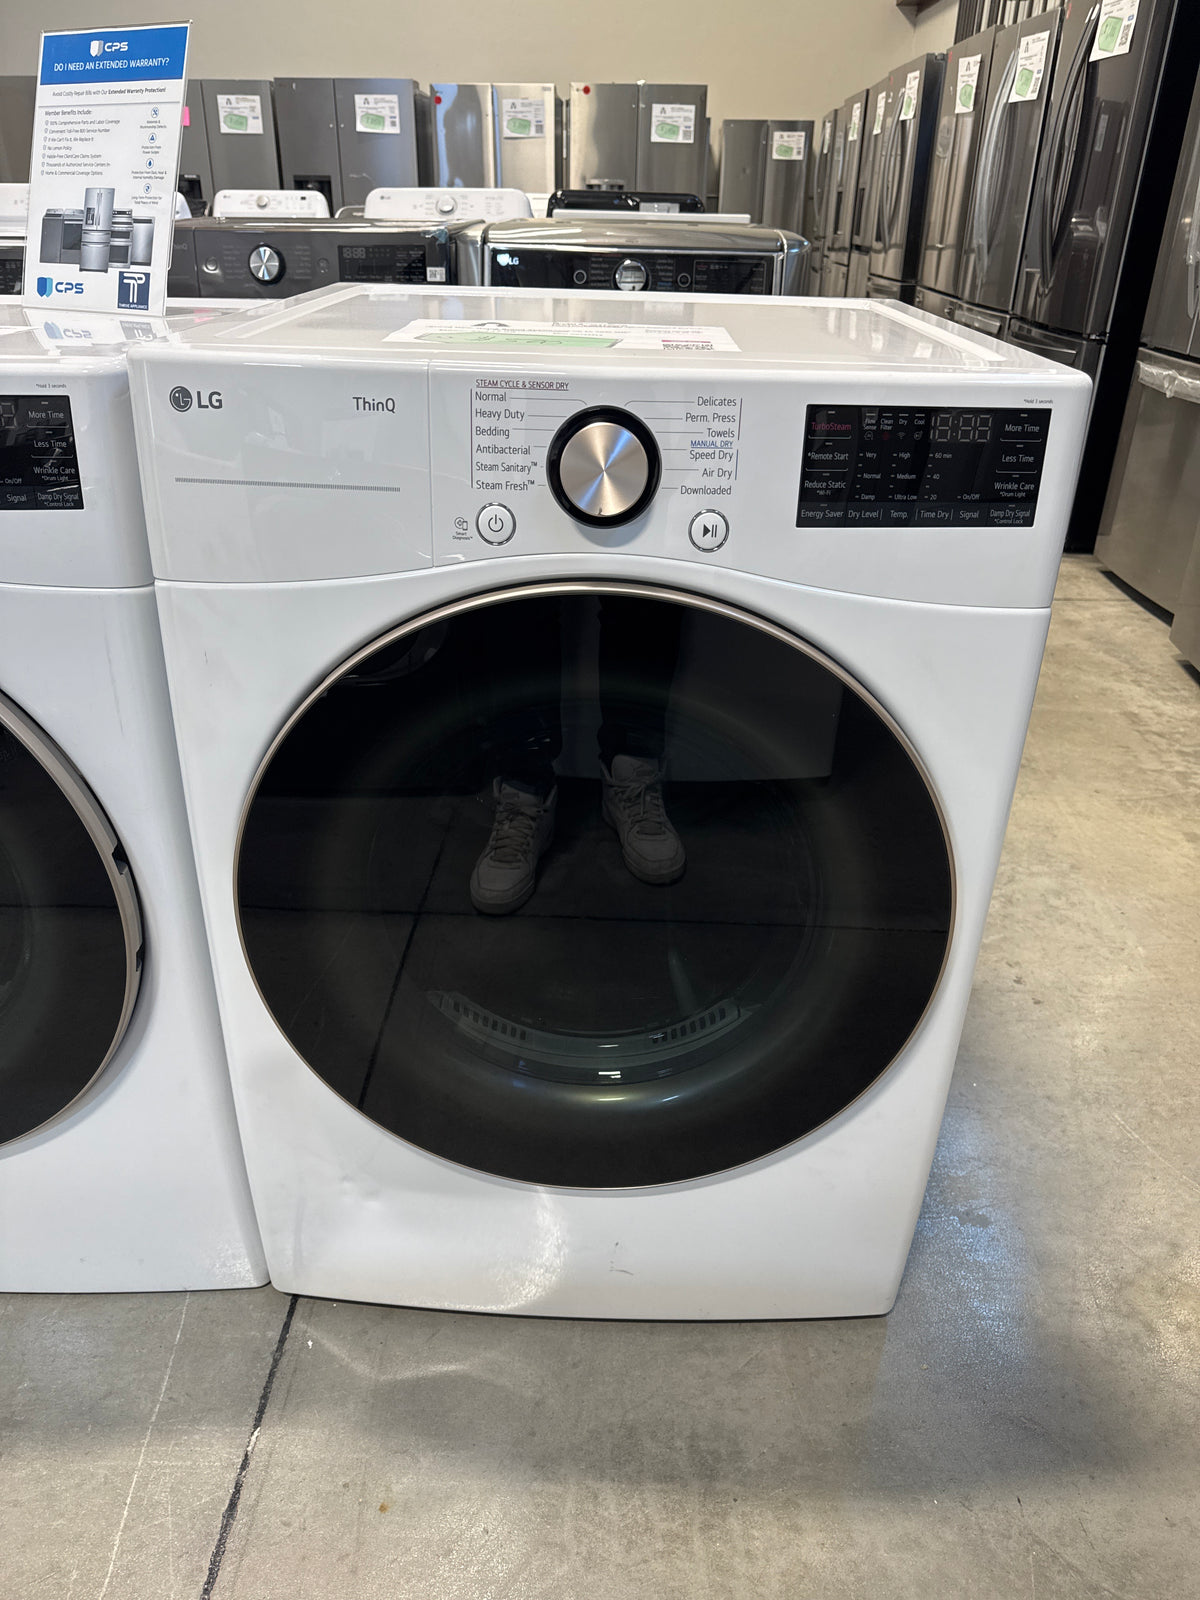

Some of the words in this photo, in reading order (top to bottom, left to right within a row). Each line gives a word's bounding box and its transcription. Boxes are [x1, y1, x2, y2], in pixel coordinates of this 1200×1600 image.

[104, 42, 129, 52] CPS
[54, 63, 64, 72] DO
[64, 63, 67, 71] I
[68, 62, 84, 71] NEED
[85, 62, 95, 70] AN
[96, 60, 128, 70] EXTENDED
[130, 58, 170, 68] WARRANTY?
[508, 257, 519, 266] LG
[55, 282, 84, 295] CPS
[476, 379, 498, 388] STEAM
[500, 380, 520, 388] CYCLE
[528, 381, 554, 389] SENSOR
[556, 382, 569, 390] DRY
[196, 391, 223, 410] LG
[475, 391, 507, 402] Normal
[697, 396, 737, 407] Delicates
[352, 397, 396, 414] ThinQ
[28, 410, 46, 419] More
[48, 411, 65, 419] Time
[475, 408, 502, 421] Heavy
[504, 409, 525, 422] Duty
[686, 412, 710, 423] Perm.
[713, 412, 736, 423] Press
[811, 422, 852, 431] TurboSteam
[1005, 424, 1022, 432] More
[1023, 424, 1040, 433] Time
[475, 426, 510, 440] Bedding
[707, 428, 735, 438] Towels
[34, 440, 50, 448] Less
[51, 440, 67, 448] Time
[691, 440, 718, 448] MANUAL
[720, 440, 734, 448] DRY
[476, 444, 531, 455] Antibacterial
[690, 450, 716, 461] Speed
[718, 450, 734, 462] Dry
[834, 452, 849, 461] Start
[899, 452, 911, 460] High
[1002, 454, 1017, 463] Less
[1019, 454, 1034, 463] Time
[33, 466, 59, 474] Wrinkle
[60, 466, 76, 474] Care
[476, 462, 499, 472] Steam
[702, 468, 715, 478] Air
[717, 468, 733, 480] Dry
[476, 480, 503, 490] Steam
[804, 480, 827, 489] Reduce
[828, 481, 846, 489] Static
[994, 482, 1018, 490] Wrinkle
[1020, 482, 1035, 490] Care
[680, 485, 732, 495] Downloaded
[6, 494, 27, 504] Signal
[63, 493, 79, 501] Signal
[801, 510, 824, 519] Energy
[825, 510, 844, 518] Saver
[848, 510, 860, 519] Dry
[862, 510, 879, 518] Level
[890, 510, 908, 519] Temp.
[921, 510, 936, 519] Time
[937, 510, 949, 520] Dry
[960, 510, 979, 520] Signal
[990, 510, 1005, 518] Damp
[1006, 510, 1015, 518] Dry
[1015, 510, 1030, 519] Signal
